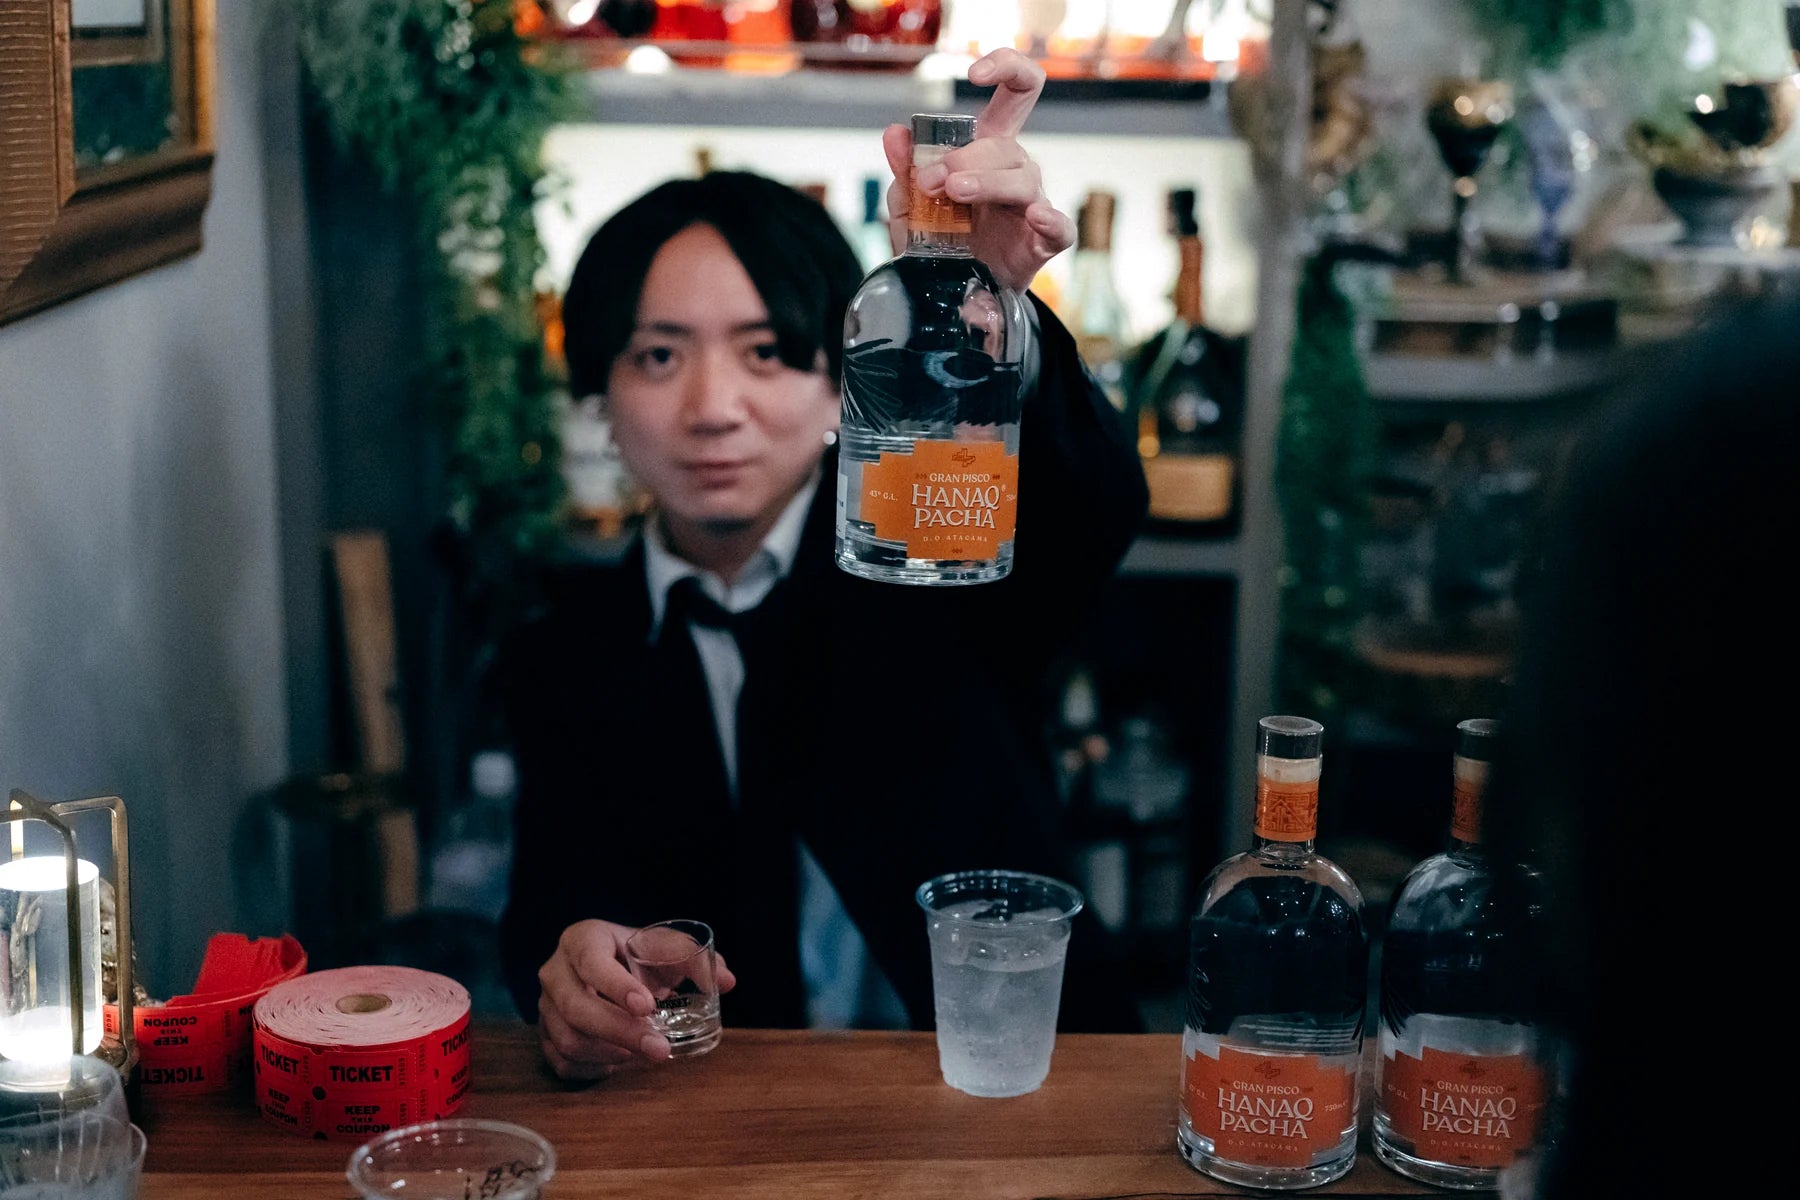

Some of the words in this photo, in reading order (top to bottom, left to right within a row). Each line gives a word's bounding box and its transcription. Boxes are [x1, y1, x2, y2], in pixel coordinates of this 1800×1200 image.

[929, 473, 960, 483] GRAN
[962, 473, 991, 483] PISCO
[911, 484, 1000, 510] HANAQ
[913, 508, 997, 529] PACHA
[143, 1016, 197, 1027] COUPON
[153, 1036, 189, 1047] KEEP
[261, 1045, 299, 1075] TICKET
[141, 1066, 205, 1085] TICKET
[329, 1065, 394, 1083] TICKET
[268, 1087, 291, 1104] KEEP
[1232, 1081, 1264, 1093] GRAN
[1266, 1085, 1300, 1095] PISCO
[1437, 1081, 1468, 1093] GRAN
[1471, 1085, 1504, 1095] PISCO
[344, 1105, 381, 1115] KEEP
[1217, 1087, 1314, 1121] HANAQ
[1420, 1087, 1517, 1121] HANAQ
[264, 1104, 298, 1126] COUPON
[336, 1124, 391, 1134] COUPON
[1219, 1111, 1309, 1140] PACHA
[1422, 1111, 1512, 1139] PACHA
